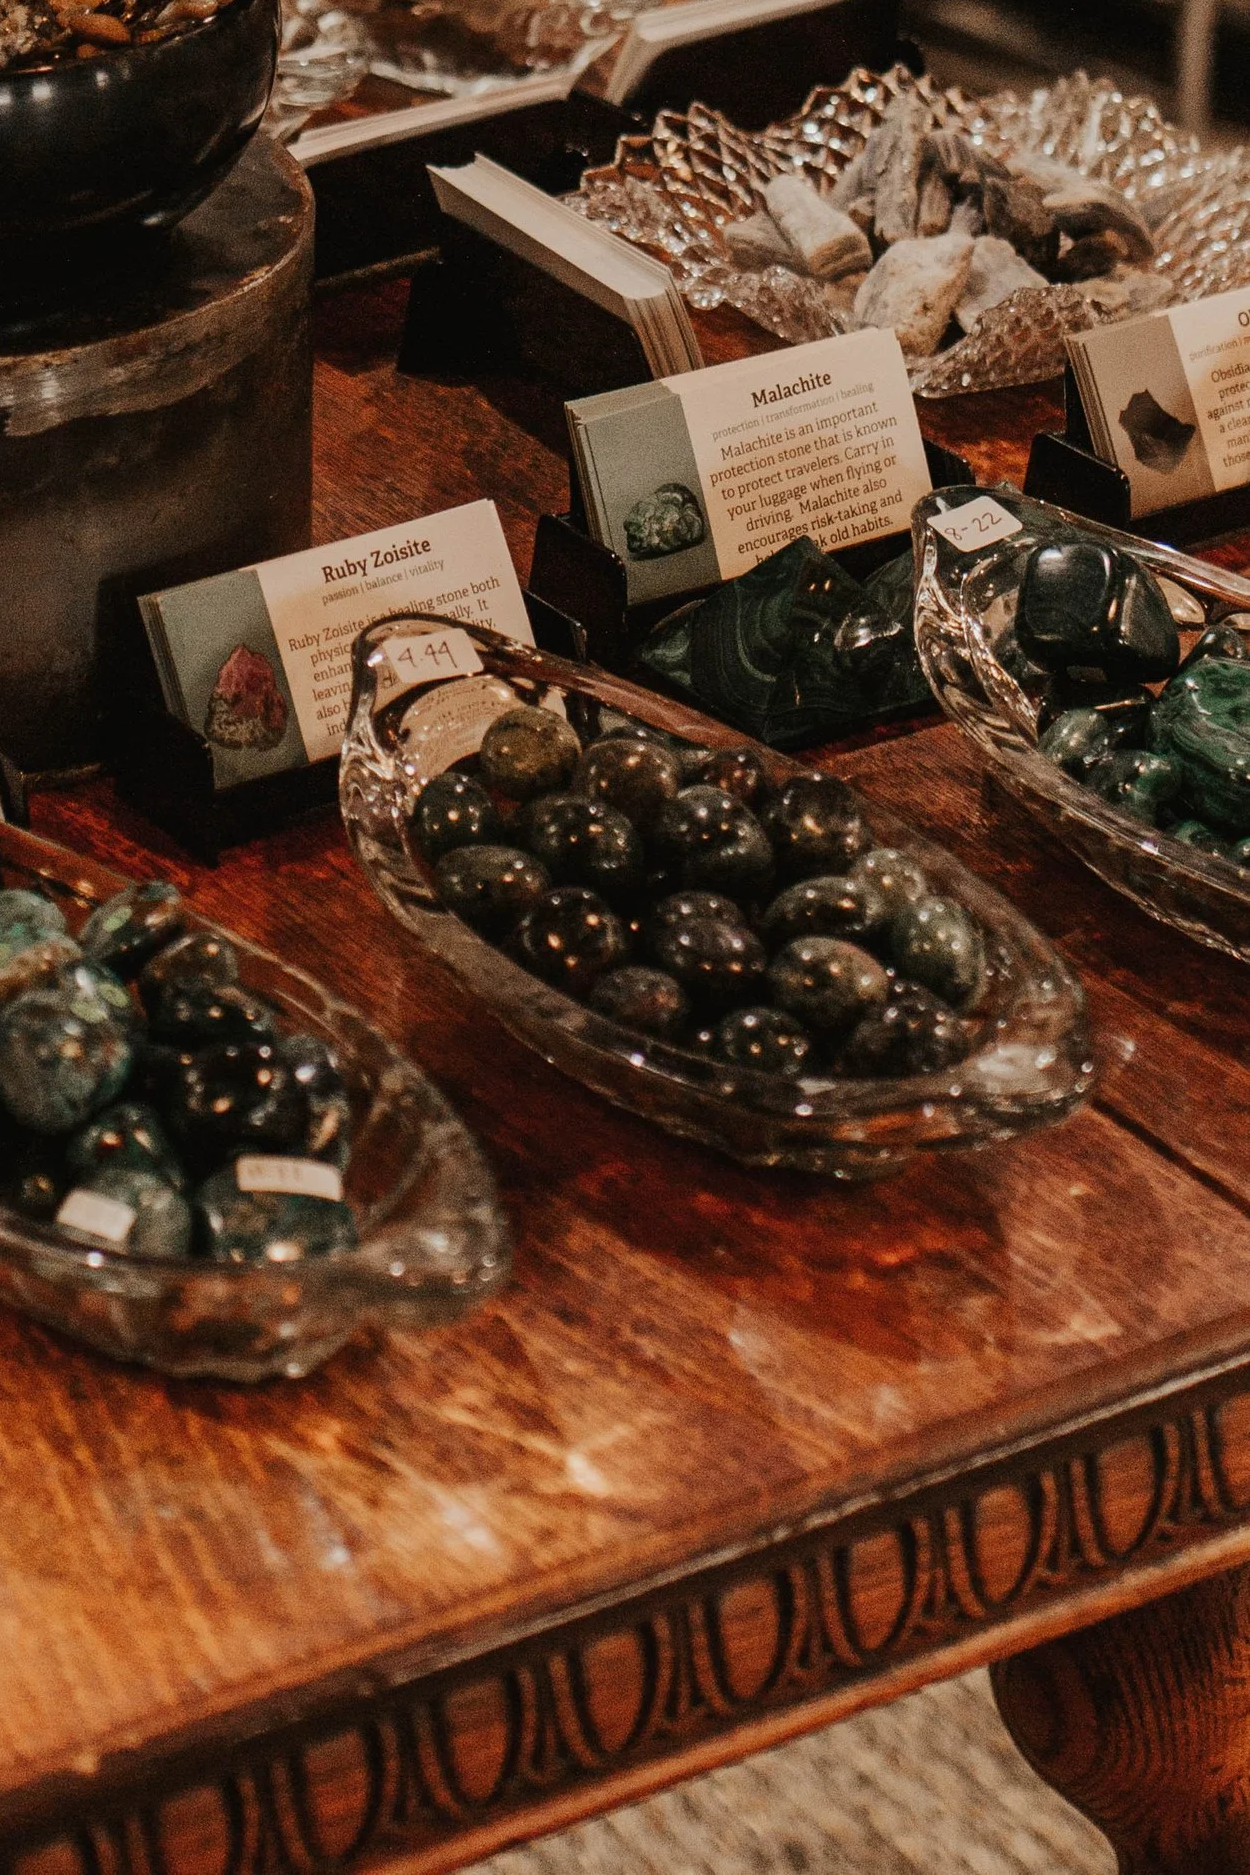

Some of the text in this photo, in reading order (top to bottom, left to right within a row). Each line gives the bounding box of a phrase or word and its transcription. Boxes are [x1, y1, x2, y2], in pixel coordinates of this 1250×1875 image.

[750, 372, 833, 408] Malachite
[1211, 362, 1250, 383] Obsidia
[1218, 380, 1250, 402] protec
[712, 418, 760, 442] protection
[765, 394, 835, 421] transformation
[840, 382, 875, 400] healing
[721, 401, 879, 460] Malachite is an important
[1207, 399, 1245, 421] against
[1219, 424, 1226, 434] a
[710, 416, 898, 487] protection stone that is known
[721, 436, 895, 500] to protect travelers. Carry in
[727, 455, 897, 521] your luggage when flying or
[746, 477, 887, 532] driving. Malachite also
[738, 489, 903, 554] encourages risk-taking and
[830, 527, 850, 544] old
[852, 516, 894, 537] habits.
[944, 512, 1003, 541] 8-22
[321, 538, 432, 584] Ruby Zoisite
[322, 587, 360, 606] passion
[366, 573, 403, 591] balance
[409, 558, 445, 578] vitality
[288, 634, 320, 652] Ruby
[322, 620, 364, 642] Zoisite
[436, 589, 470, 607] stone
[471, 576, 501, 594] both
[310, 643, 351, 668] physic
[478, 599, 489, 611] It
[313, 662, 352, 682] enhan
[397, 641, 458, 669] 4.44
[311, 682, 351, 701] leavin
[316, 702, 341, 720] also
